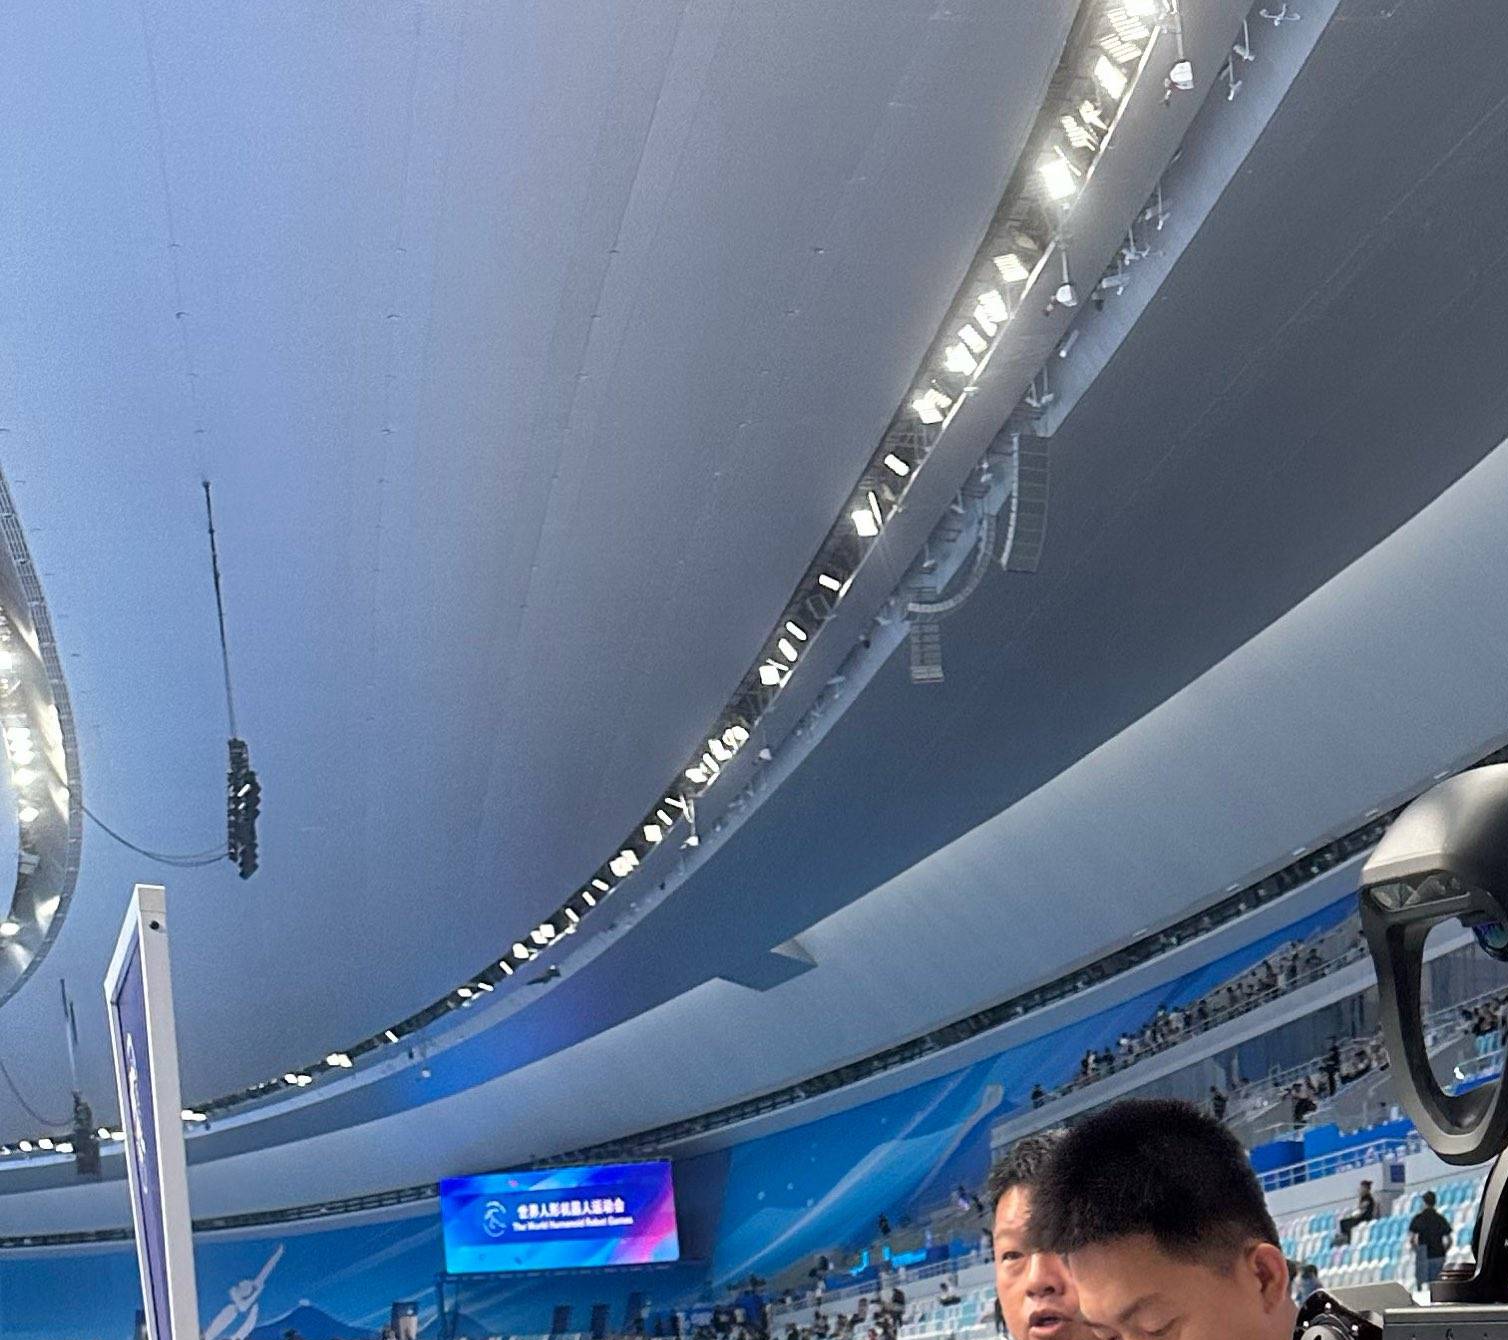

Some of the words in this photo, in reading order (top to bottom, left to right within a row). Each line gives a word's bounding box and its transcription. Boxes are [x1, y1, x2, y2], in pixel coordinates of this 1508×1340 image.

[517, 1197, 625, 1219] 世界人形机器人运动会
